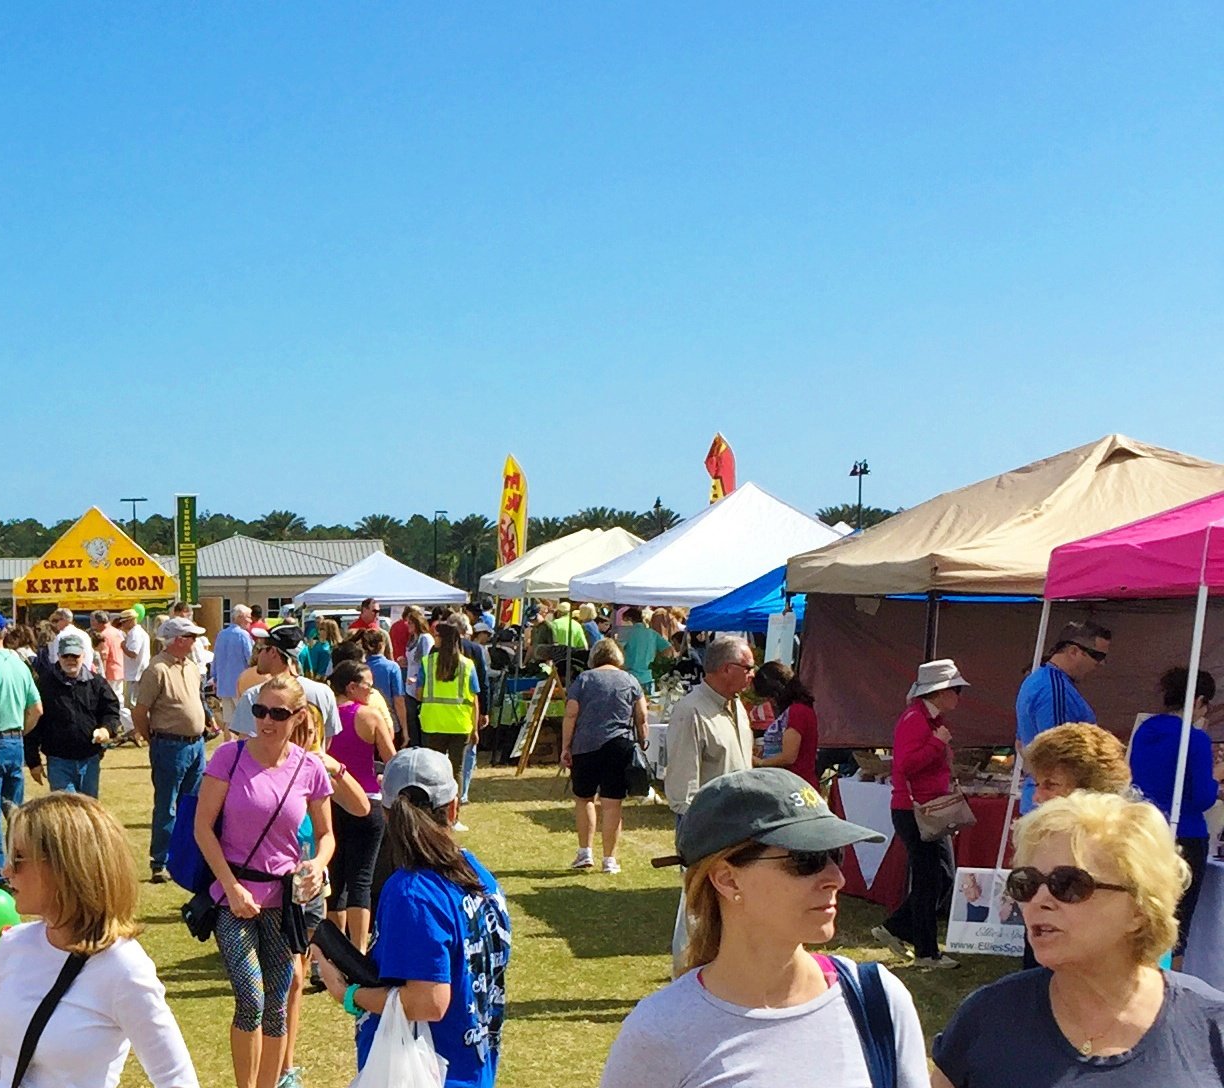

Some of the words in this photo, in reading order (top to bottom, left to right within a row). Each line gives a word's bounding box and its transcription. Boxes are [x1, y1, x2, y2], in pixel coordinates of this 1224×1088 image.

[43, 559, 83, 569] CRAZY
[114, 557, 145, 567] GOOD
[26, 577, 99, 594] KETTLE
[116, 575, 165, 591] CORN
